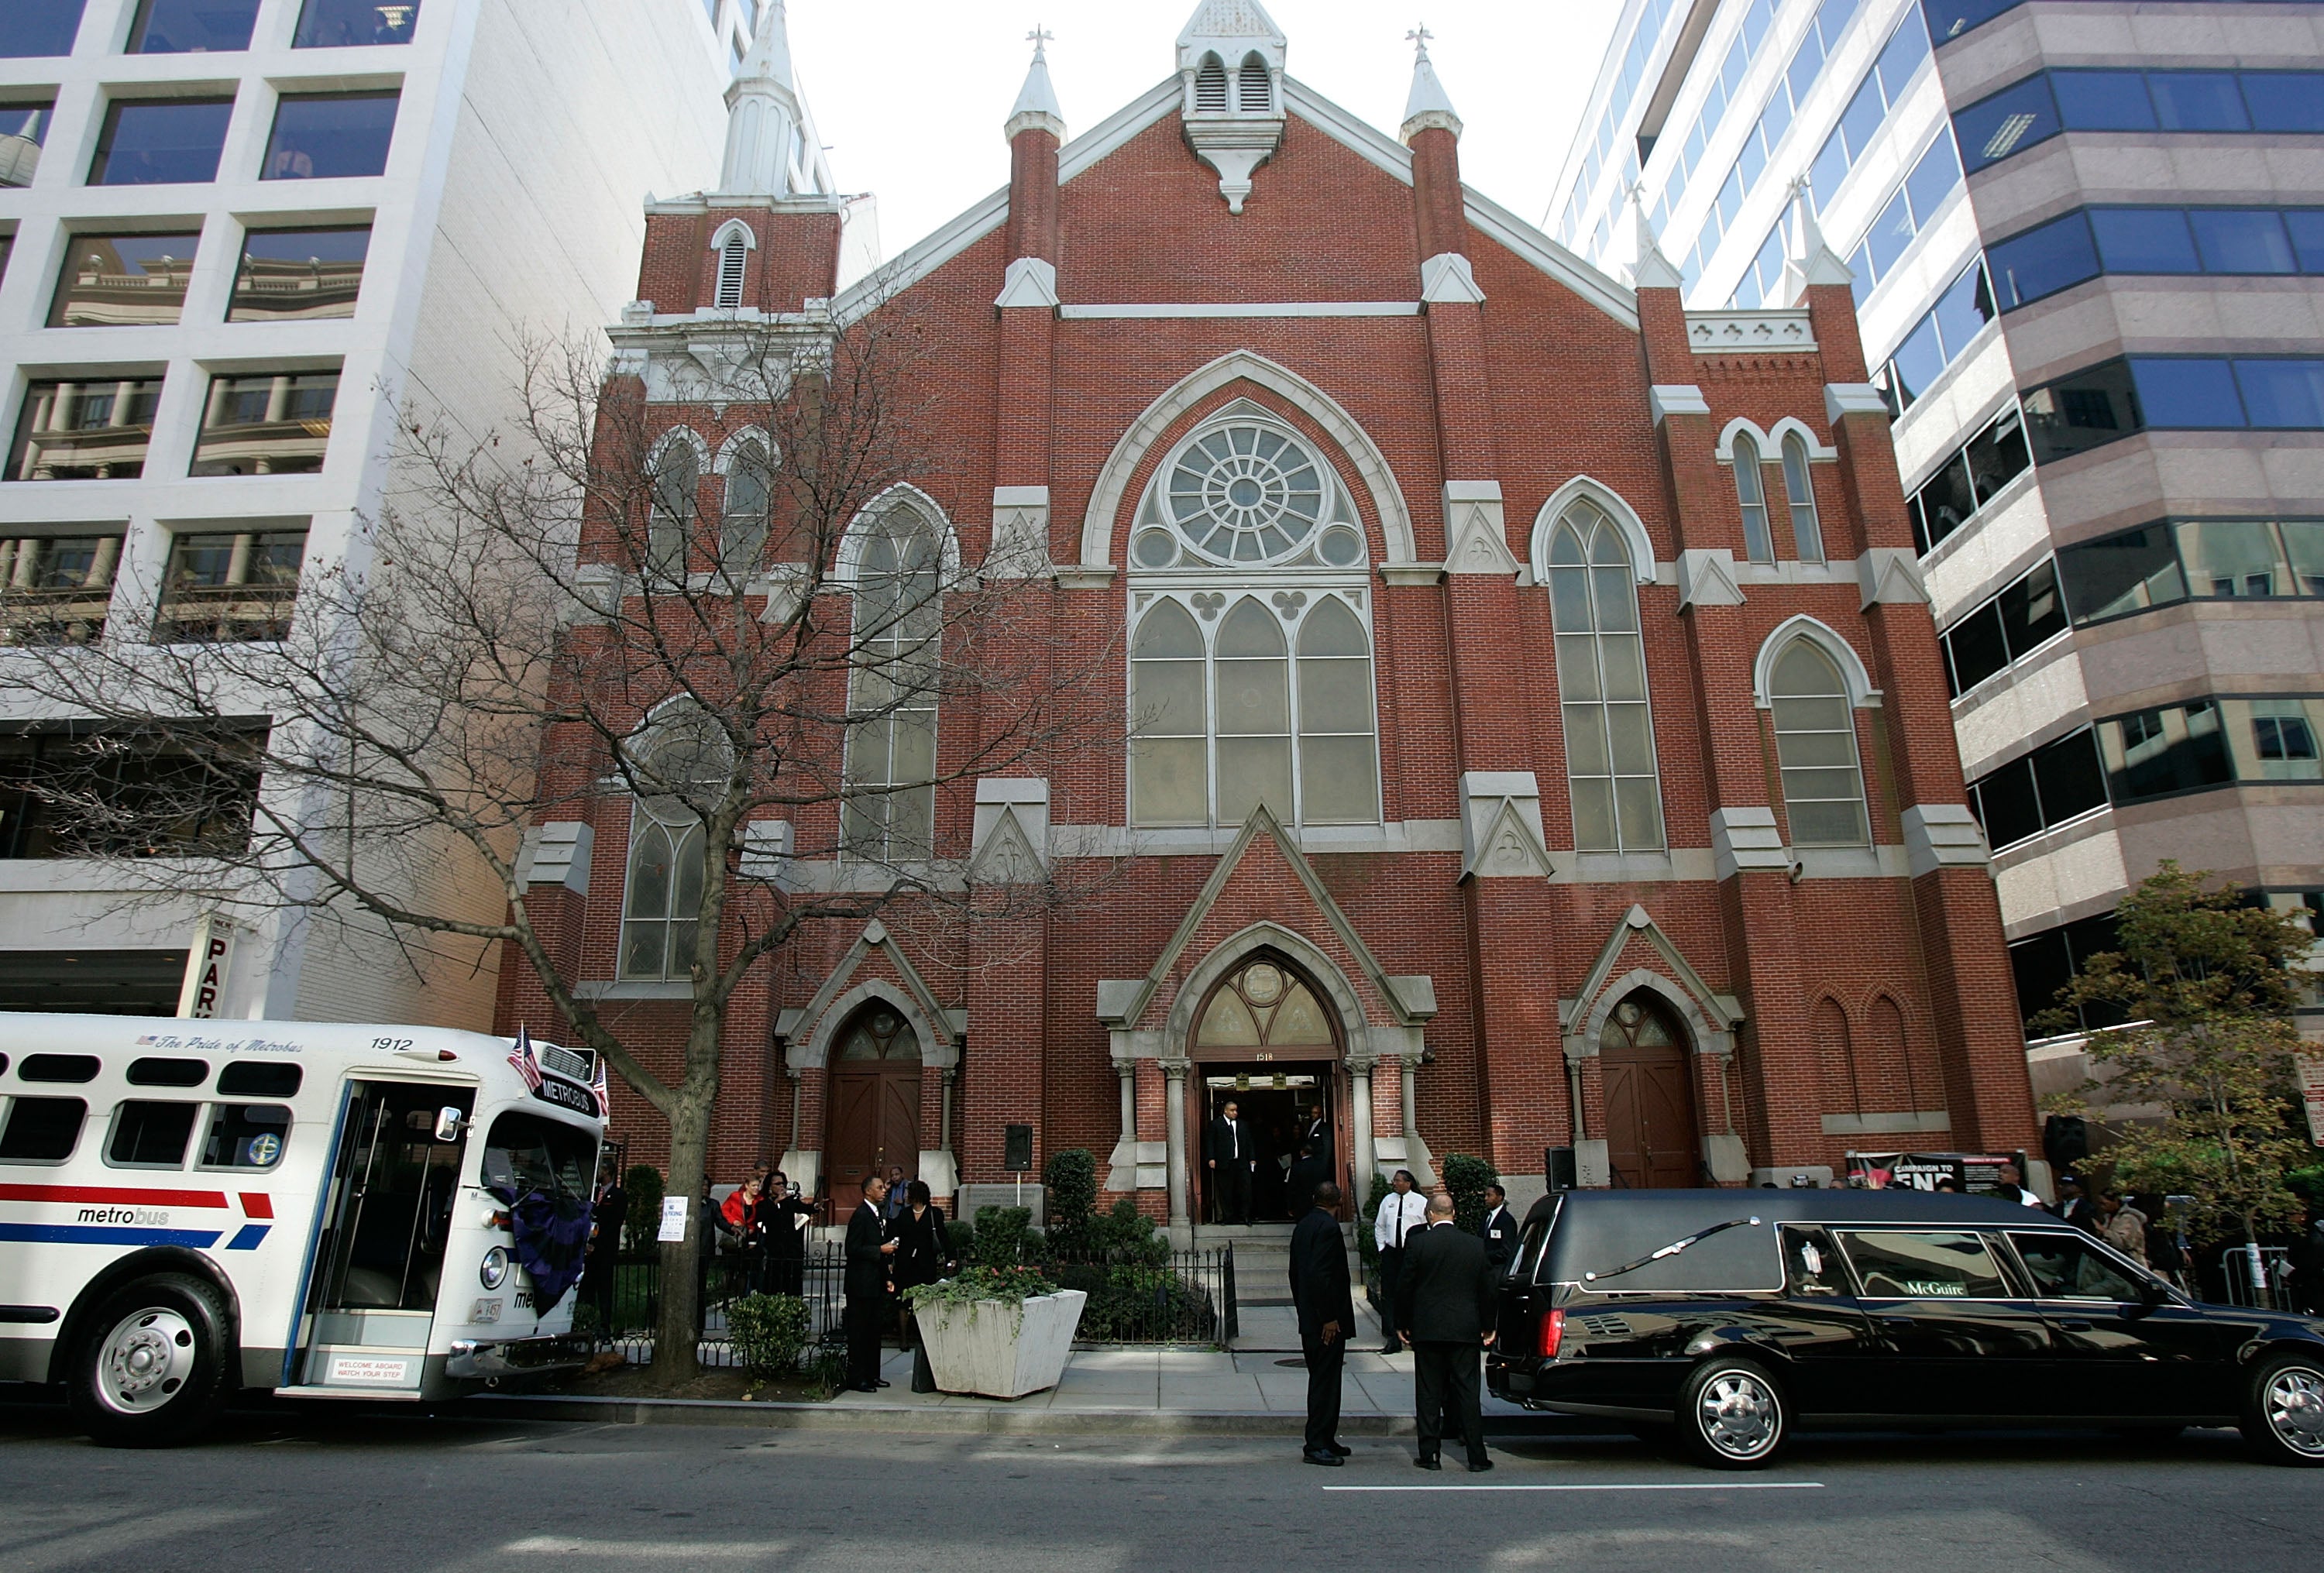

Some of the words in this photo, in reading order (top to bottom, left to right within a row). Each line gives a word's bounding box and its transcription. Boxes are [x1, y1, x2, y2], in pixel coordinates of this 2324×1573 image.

[194, 938, 226, 1018] PAR
[156, 1036, 183, 1049] The
[184, 1036, 221, 1049] Pride
[225, 1039, 246, 1053] of
[245, 1039, 304, 1053] Metrobus
[371, 1037, 414, 1051] 1912
[1257, 1053, 1273, 1062] 1518
[542, 1078, 590, 1111] METROBUS
[1894, 1164, 1939, 1174] CAMPAIGN
[1940, 1164, 1954, 1173] TO
[77, 1207, 169, 1225] metrobus
[1907, 1281, 1965, 1295] McGuire
